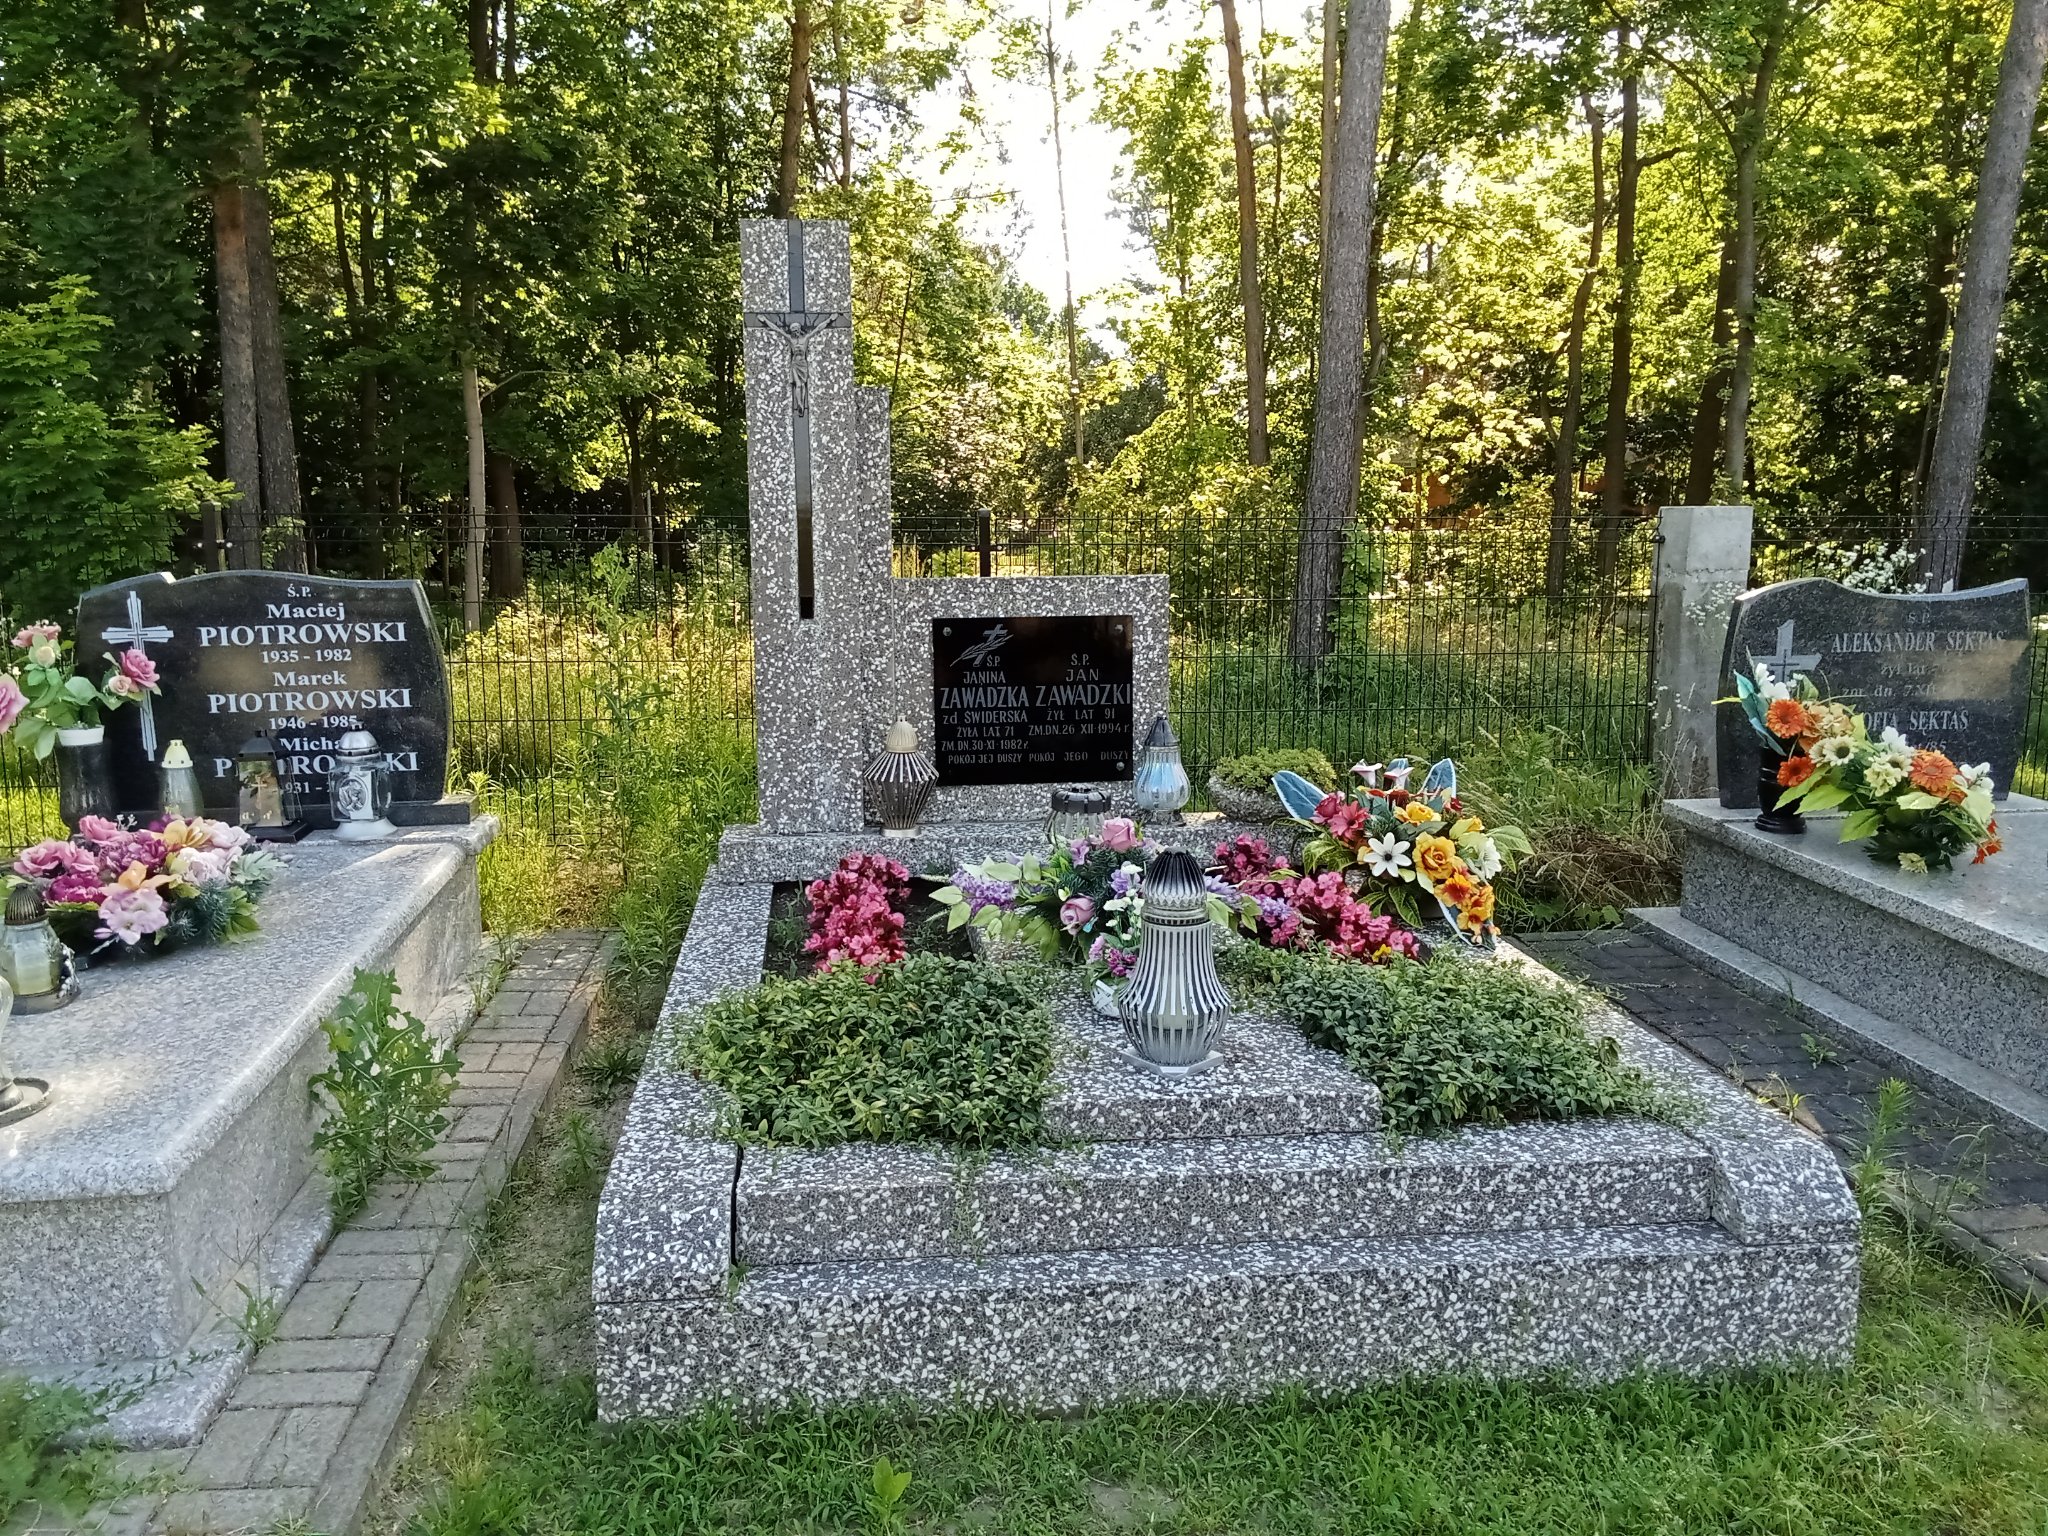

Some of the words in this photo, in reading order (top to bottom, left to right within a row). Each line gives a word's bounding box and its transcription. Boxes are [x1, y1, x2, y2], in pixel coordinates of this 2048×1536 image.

[265, 602, 345, 621] Maciej
[197, 621, 408, 647] PIOTROWSKI
[1831, 631, 1936, 653] ALEKSANDER
[262, 650, 299, 664] 1935
[316, 648, 352, 662] 1982
[273, 670, 347, 687] Marek
[963, 671, 1006, 684] JANINA
[1065, 668, 1099, 682] JAN
[207, 687, 413, 714] PIOTROWSKI
[940, 686, 1029, 708] ZAWADZKA
[1035, 683, 1131, 706] ZAWADZKI
[1047, 707, 1065, 720] ŻYŁ
[1075, 709, 1094, 720] LAT
[1104, 707, 1115, 719] 91
[1864, 710, 1898, 732] OFIA
[269, 716, 306, 730] 1946
[983, 726, 1001, 737] LAT
[1005, 725, 1014, 737] 71
[948, 753, 976, 764] POKÓJ
[978, 754, 994, 763] JEJ
[997, 752, 1023, 763] DUSZY
[1064, 751, 1088, 761] JEGO
[1100, 750, 1129, 760] DUSZY
